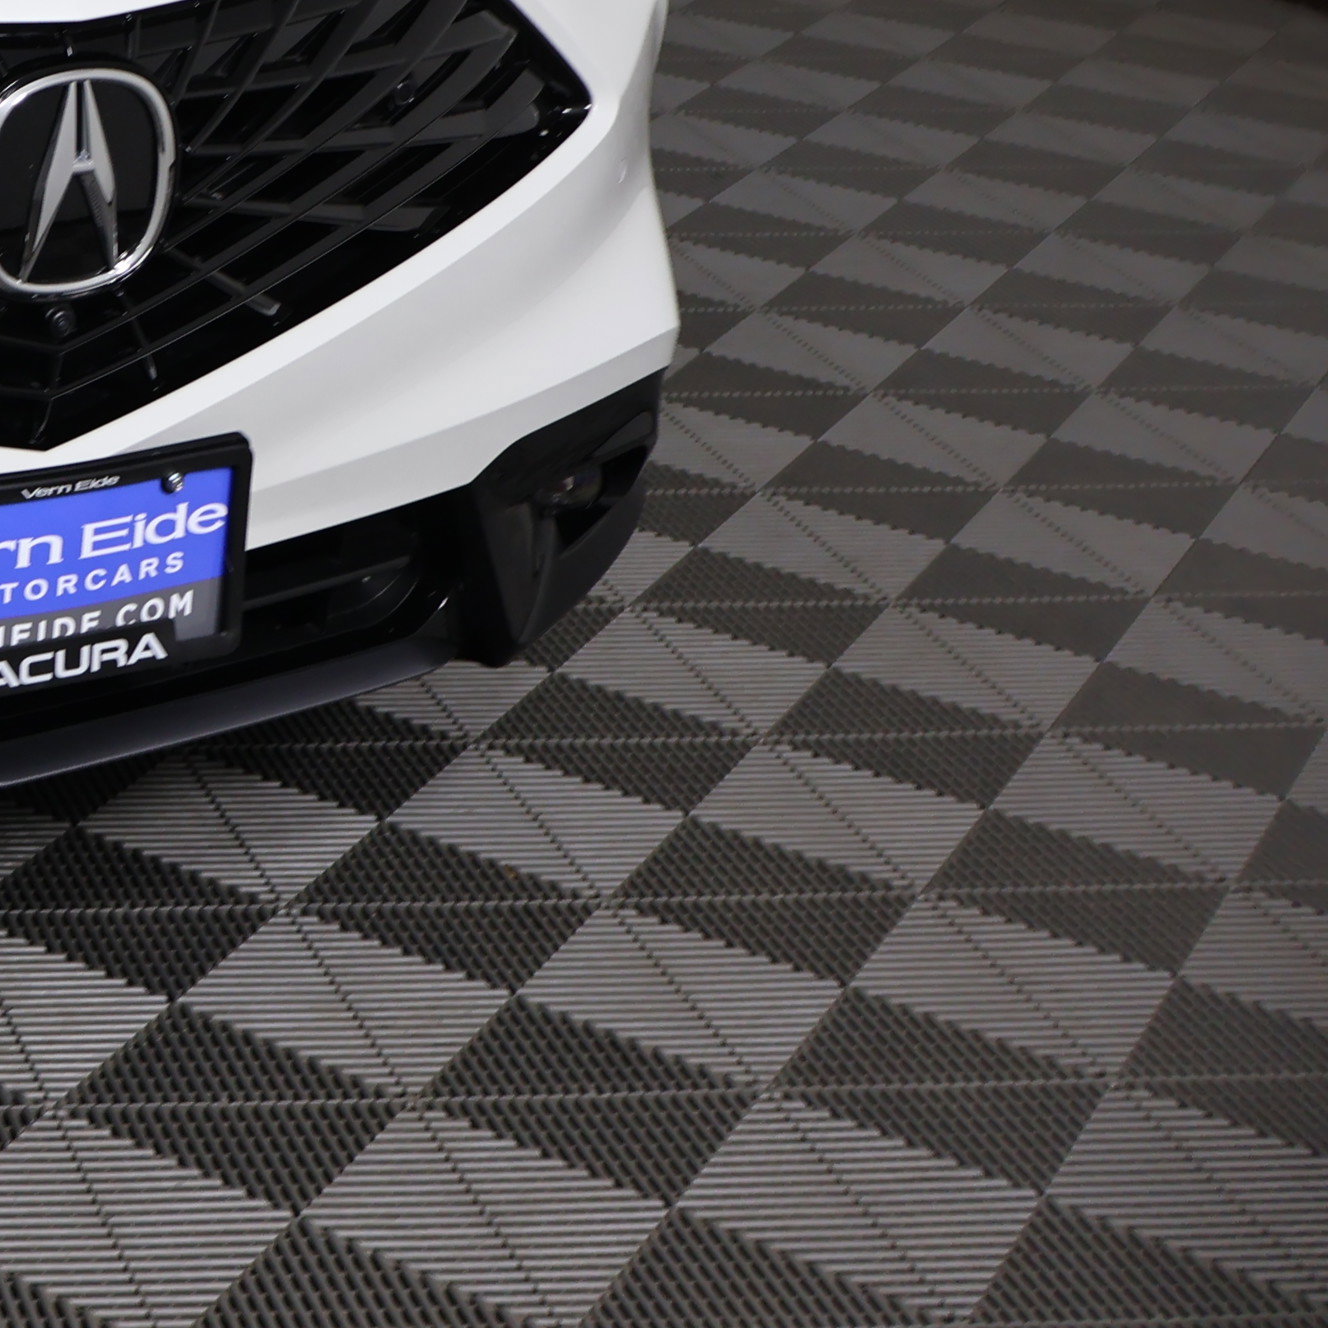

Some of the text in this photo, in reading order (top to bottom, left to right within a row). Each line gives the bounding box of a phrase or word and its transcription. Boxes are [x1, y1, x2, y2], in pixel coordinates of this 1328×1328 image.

[21, 475, 120, 500] Vern Eide
[78, 502, 229, 560] Eide
